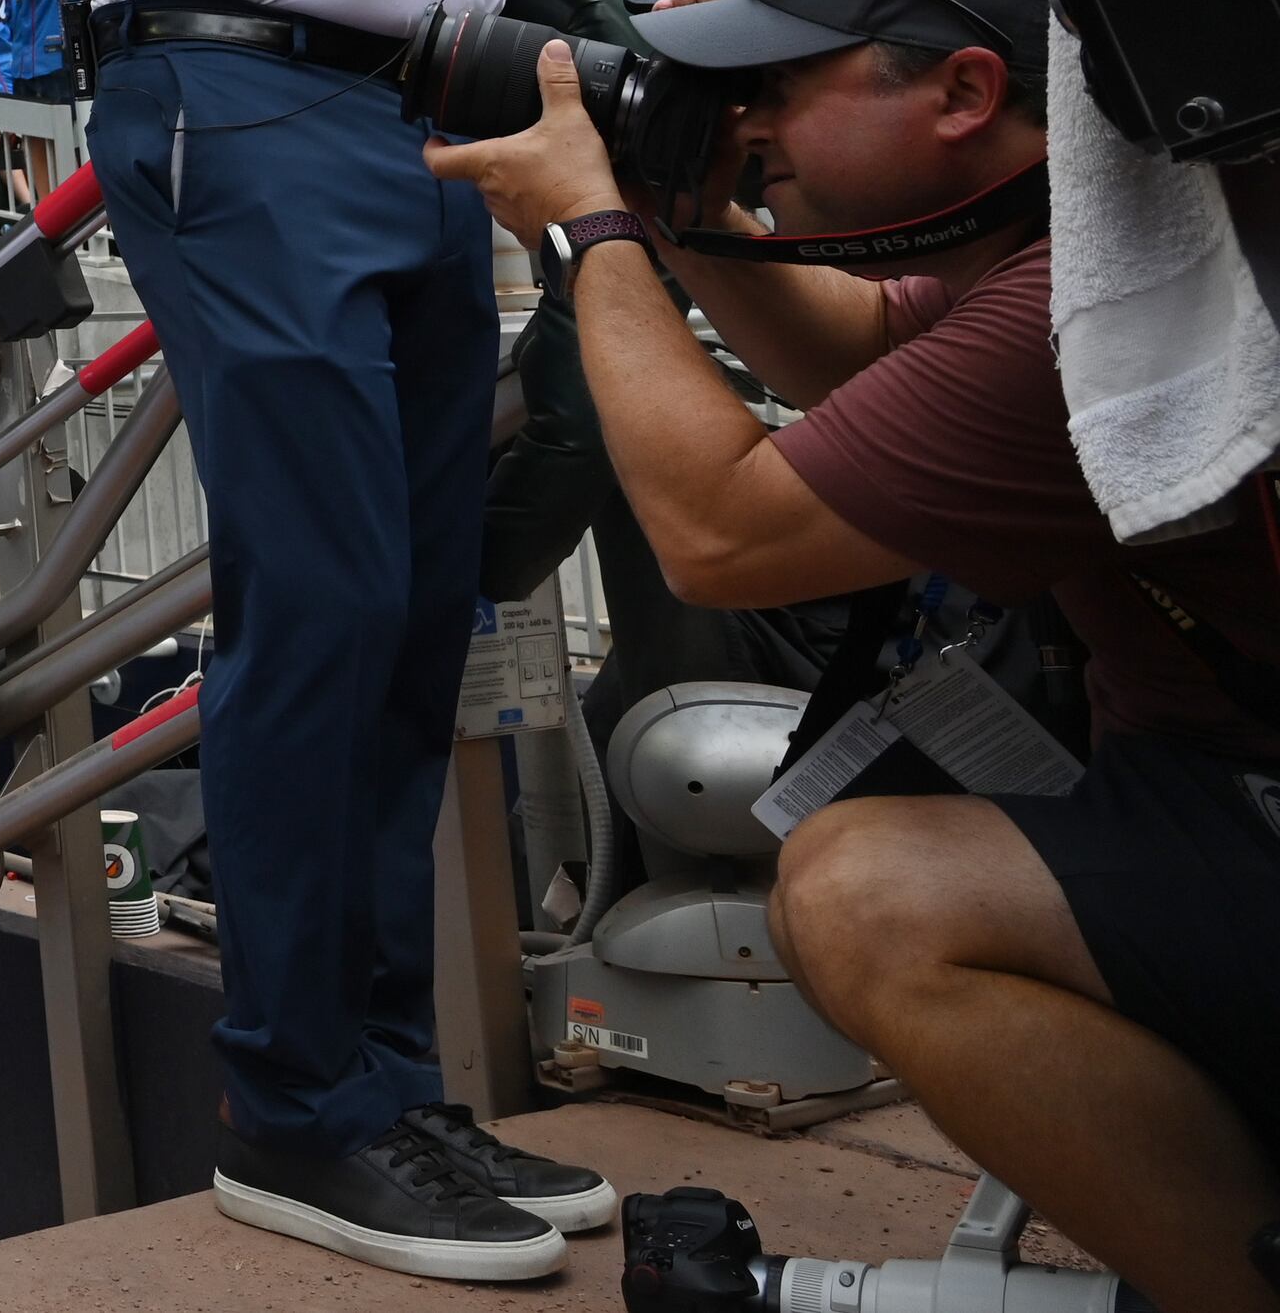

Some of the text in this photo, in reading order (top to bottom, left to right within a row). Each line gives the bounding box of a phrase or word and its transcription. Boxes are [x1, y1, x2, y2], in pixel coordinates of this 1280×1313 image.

[798, 241, 867, 257] EOS
[871, 234, 909, 254] R5
[914, 225, 964, 248] Mark
[573, 1024, 600, 1045] S/N
